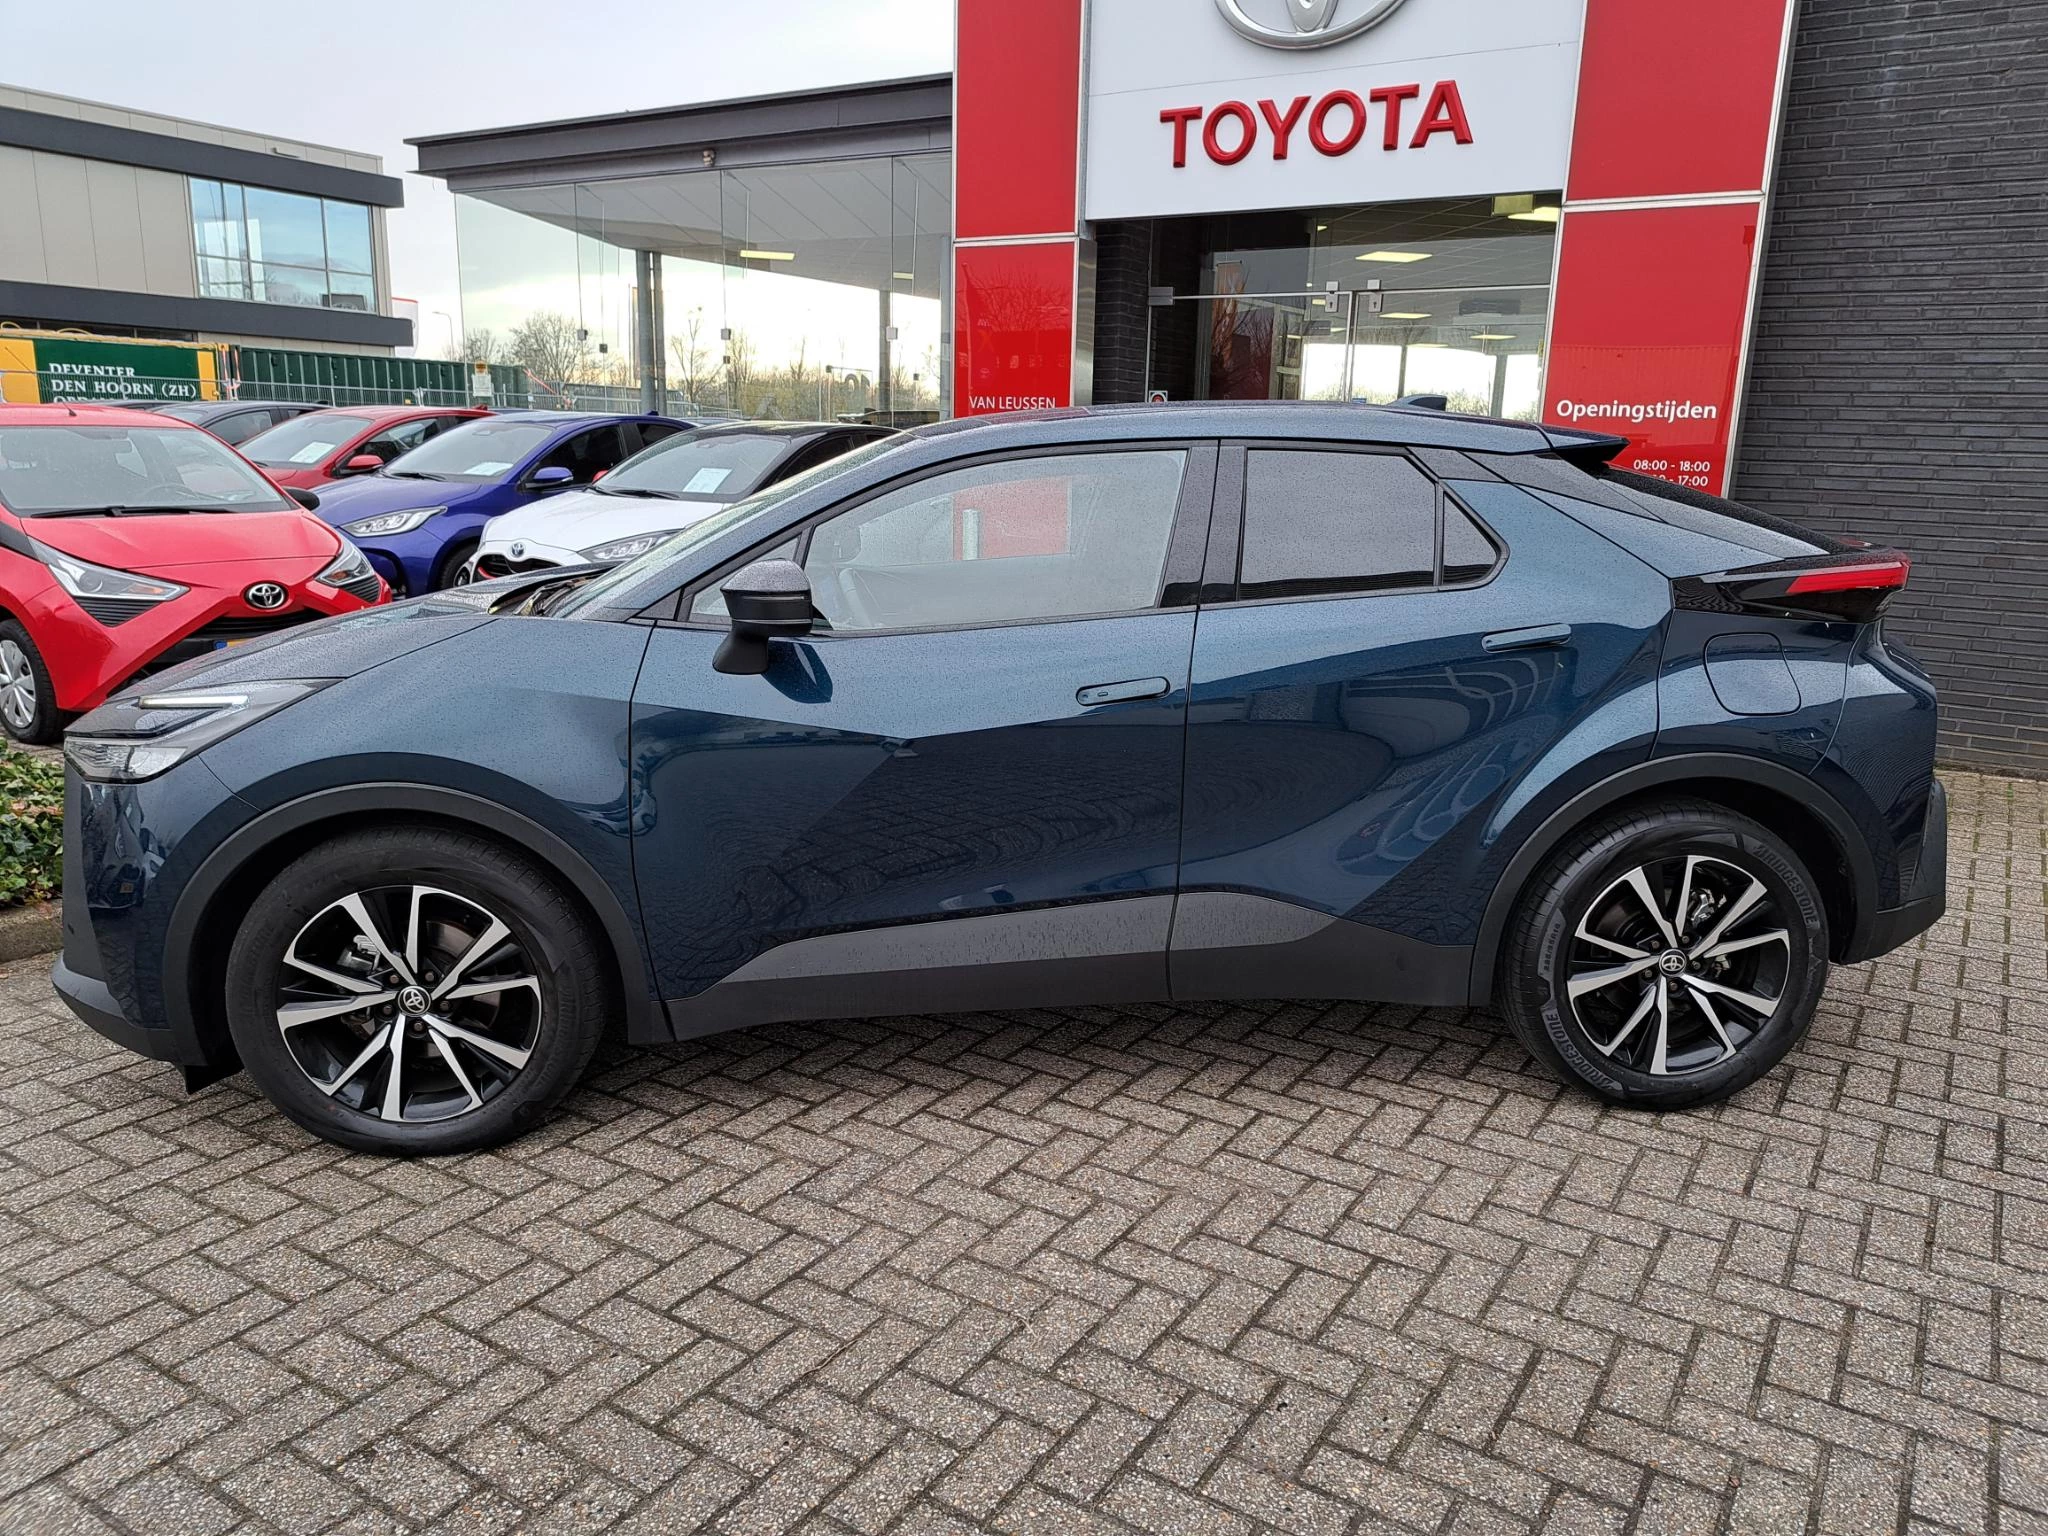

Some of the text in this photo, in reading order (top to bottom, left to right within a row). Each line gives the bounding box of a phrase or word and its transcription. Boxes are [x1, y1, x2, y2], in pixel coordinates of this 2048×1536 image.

[1160, 80, 1473, 168] TOYOTA
[49, 363, 135, 377] DEVENTER
[51, 379, 197, 398] DEN HOORN (ZH)
[969, 396, 1055, 410] VAN LEUSSEN
[1557, 400, 1717, 423] Openingstijden
[1633, 459, 1667, 471] 08:00
[1679, 461, 1710, 472] 18:00
[1678, 475, 1708, 487] 17:00
[1753, 844, 1818, 925] BRIDGESTONE
[1547, 1013, 1614, 1090] BRIDGESTONE
